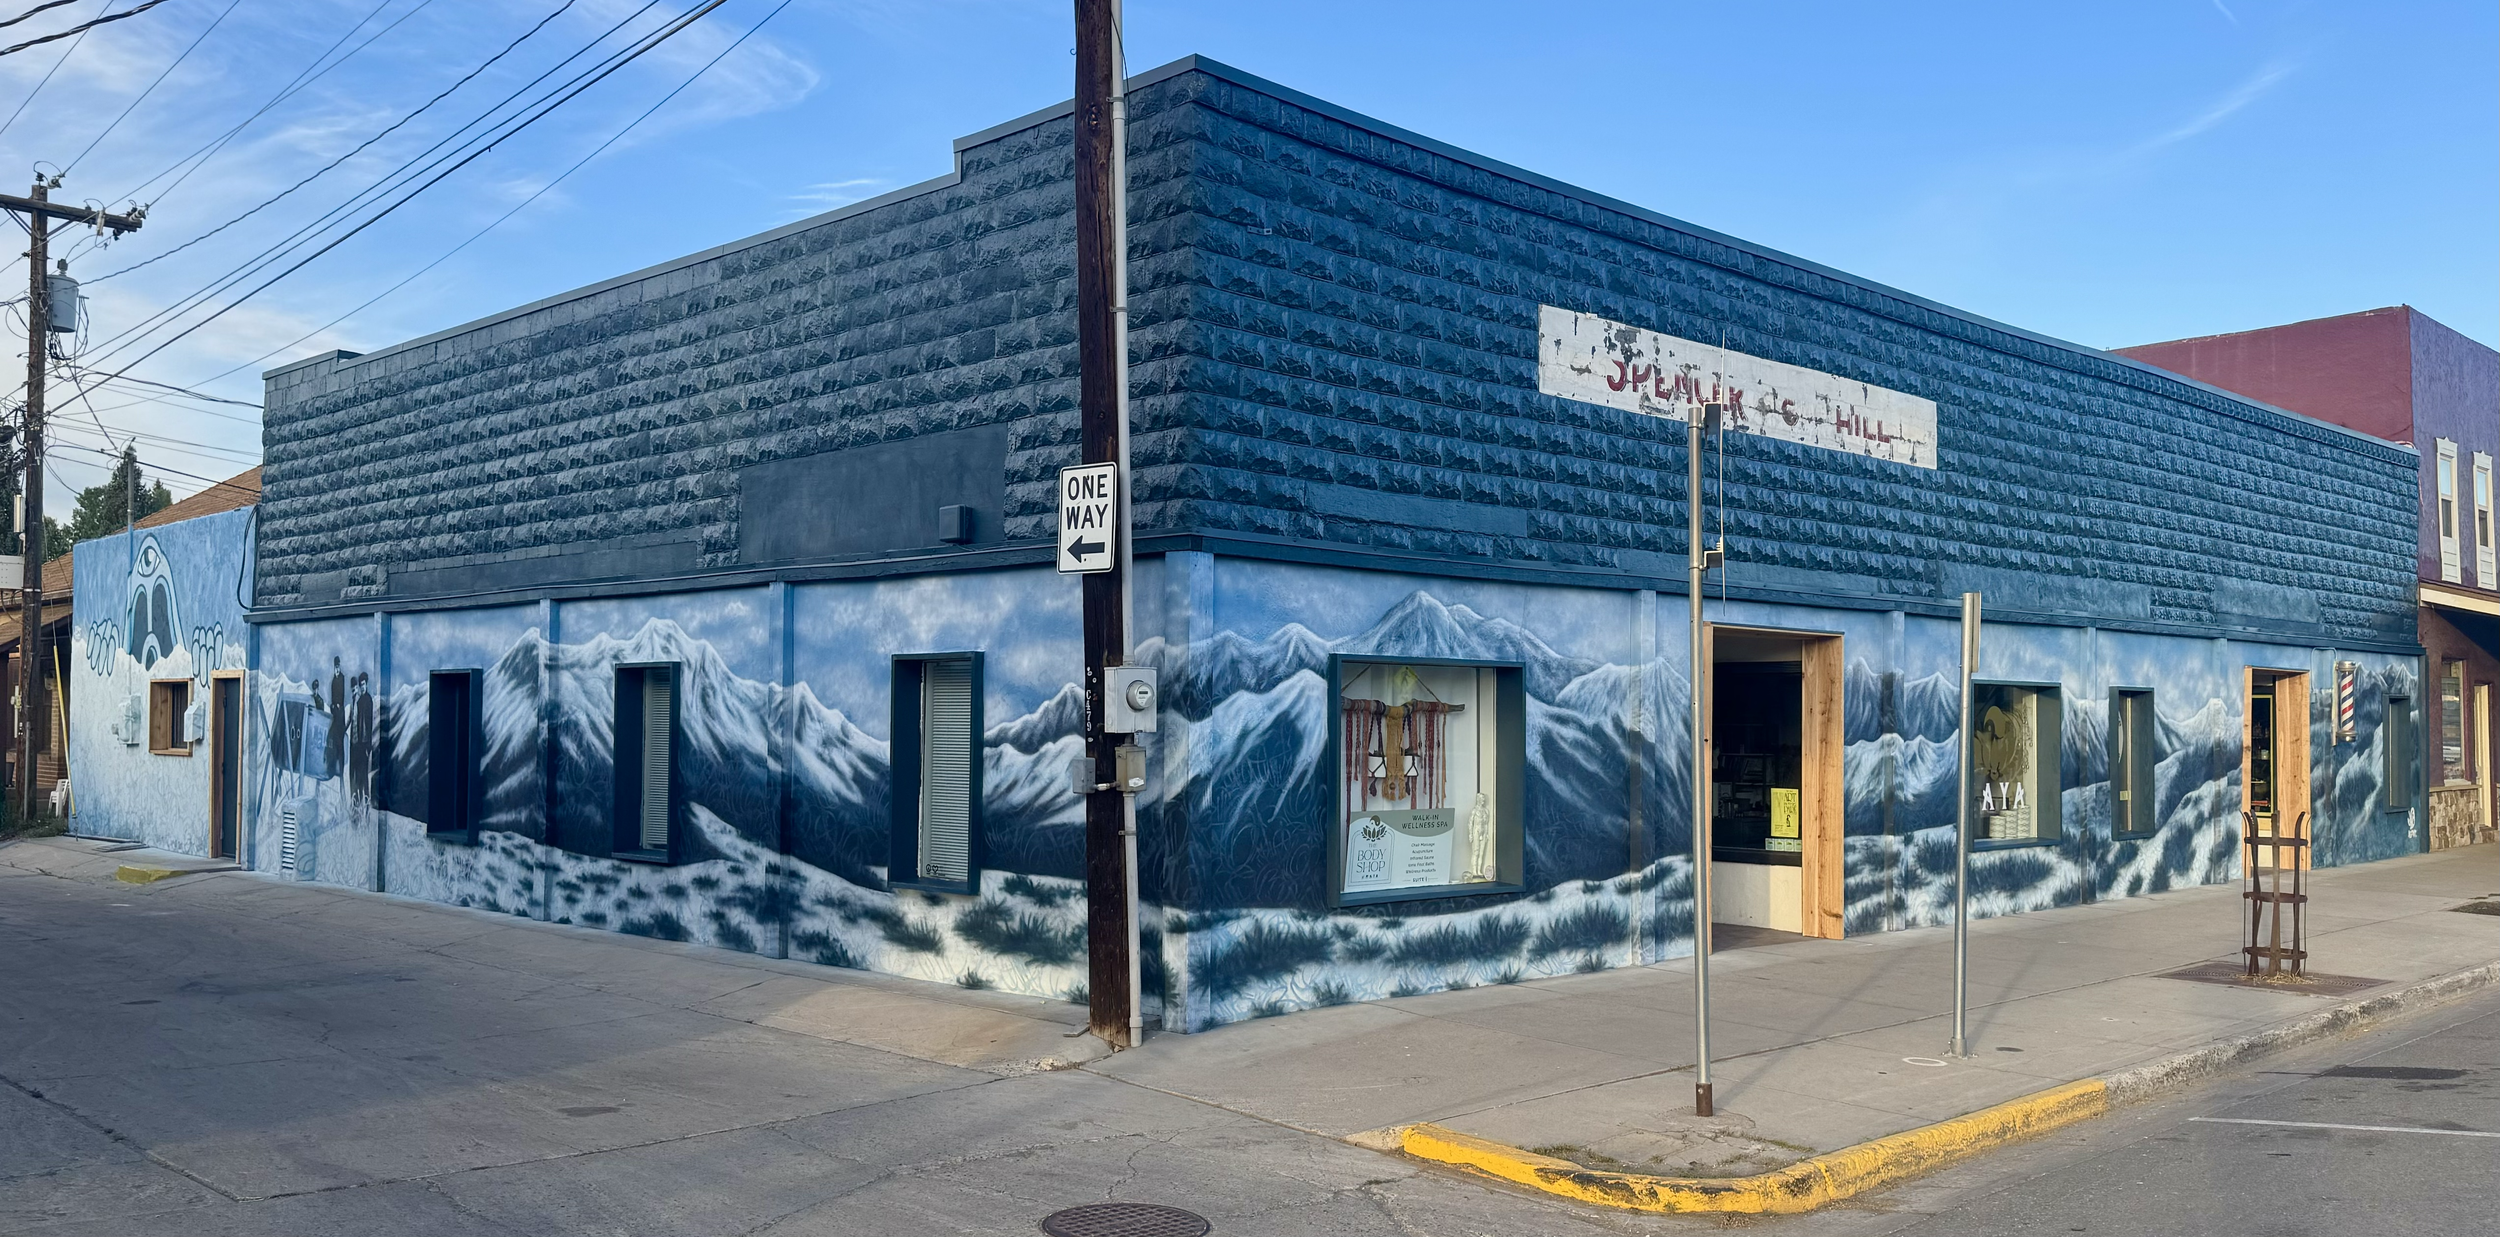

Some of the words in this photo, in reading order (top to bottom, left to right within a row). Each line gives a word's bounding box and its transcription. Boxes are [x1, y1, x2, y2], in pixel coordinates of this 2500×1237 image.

[1836, 406, 1890, 444] HILL
[1067, 474, 1108, 500] ONE
[1066, 503, 1108, 530] WAY
[1982, 782, 2025, 811] AYA
[1402, 821, 1435, 829] WELLNESS
[1436, 820, 1448, 828] SPA
[1356, 860, 1386, 873] SHOP
[1358, 848, 1387, 861] BODY
